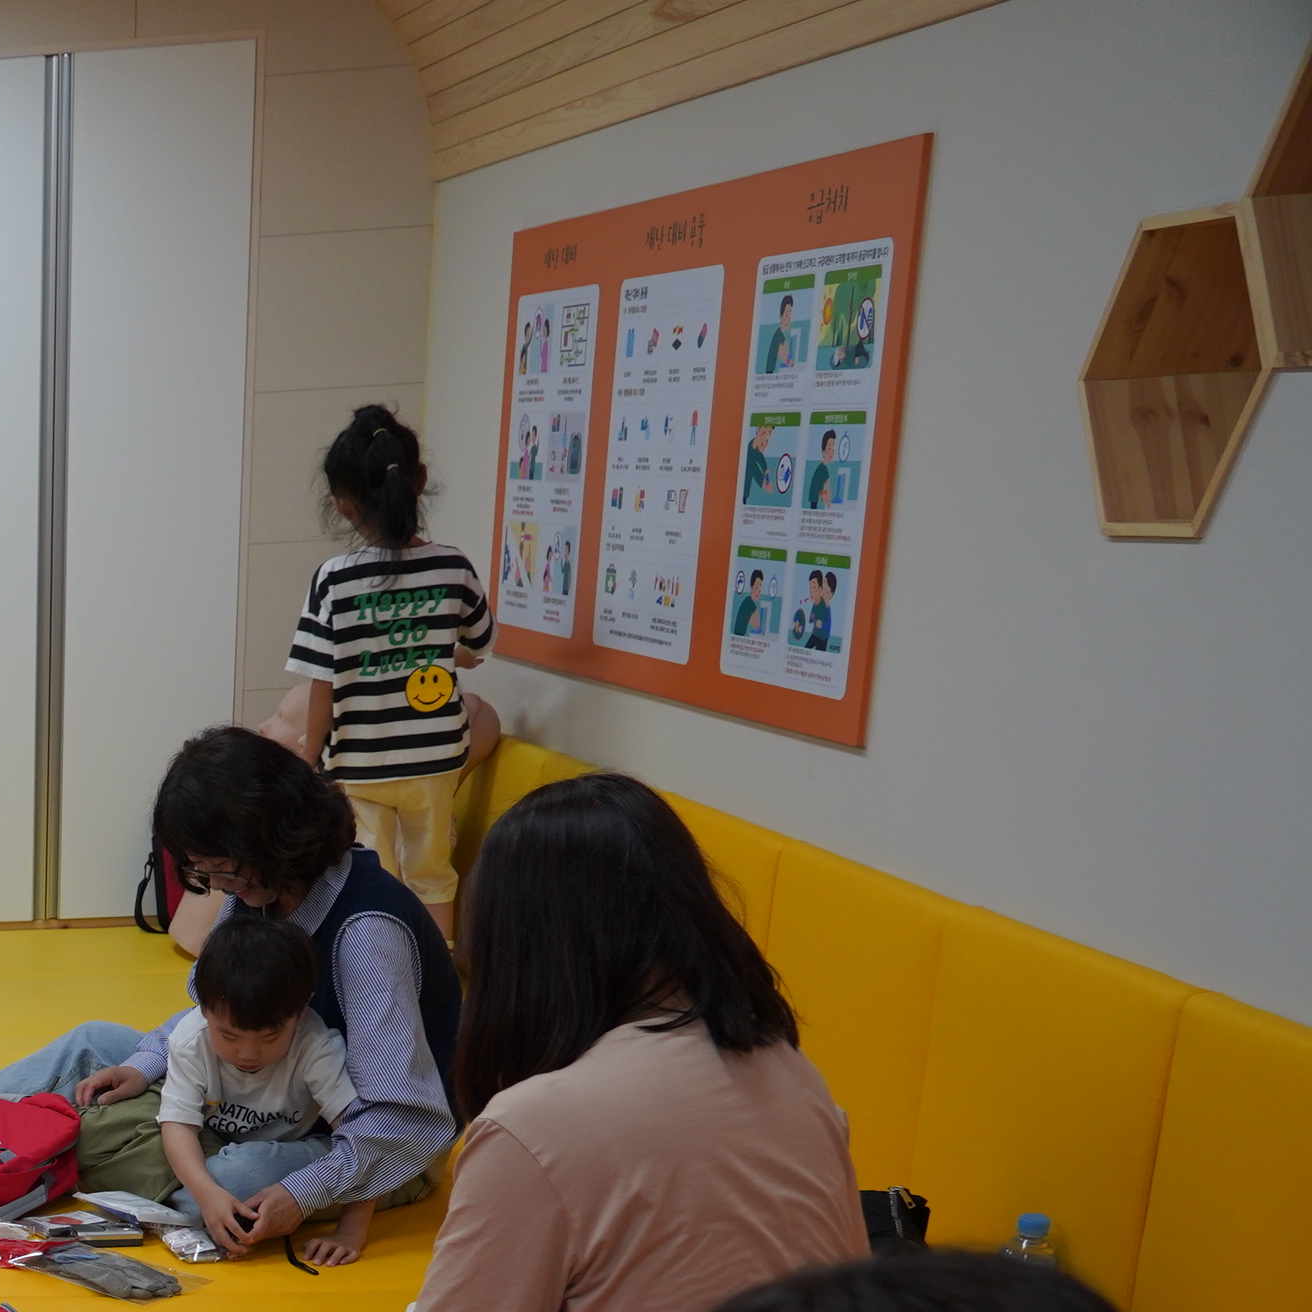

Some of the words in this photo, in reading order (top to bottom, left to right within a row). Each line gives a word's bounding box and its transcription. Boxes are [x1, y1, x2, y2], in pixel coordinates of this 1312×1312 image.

[806, 184, 850, 225] 응급처치
[644, 224, 665, 251] 재난
[667, 219, 688, 247] 대비
[353, 587, 448, 631] Happy
[388, 618, 429, 647] Go
[358, 645, 442, 674] Lucky
